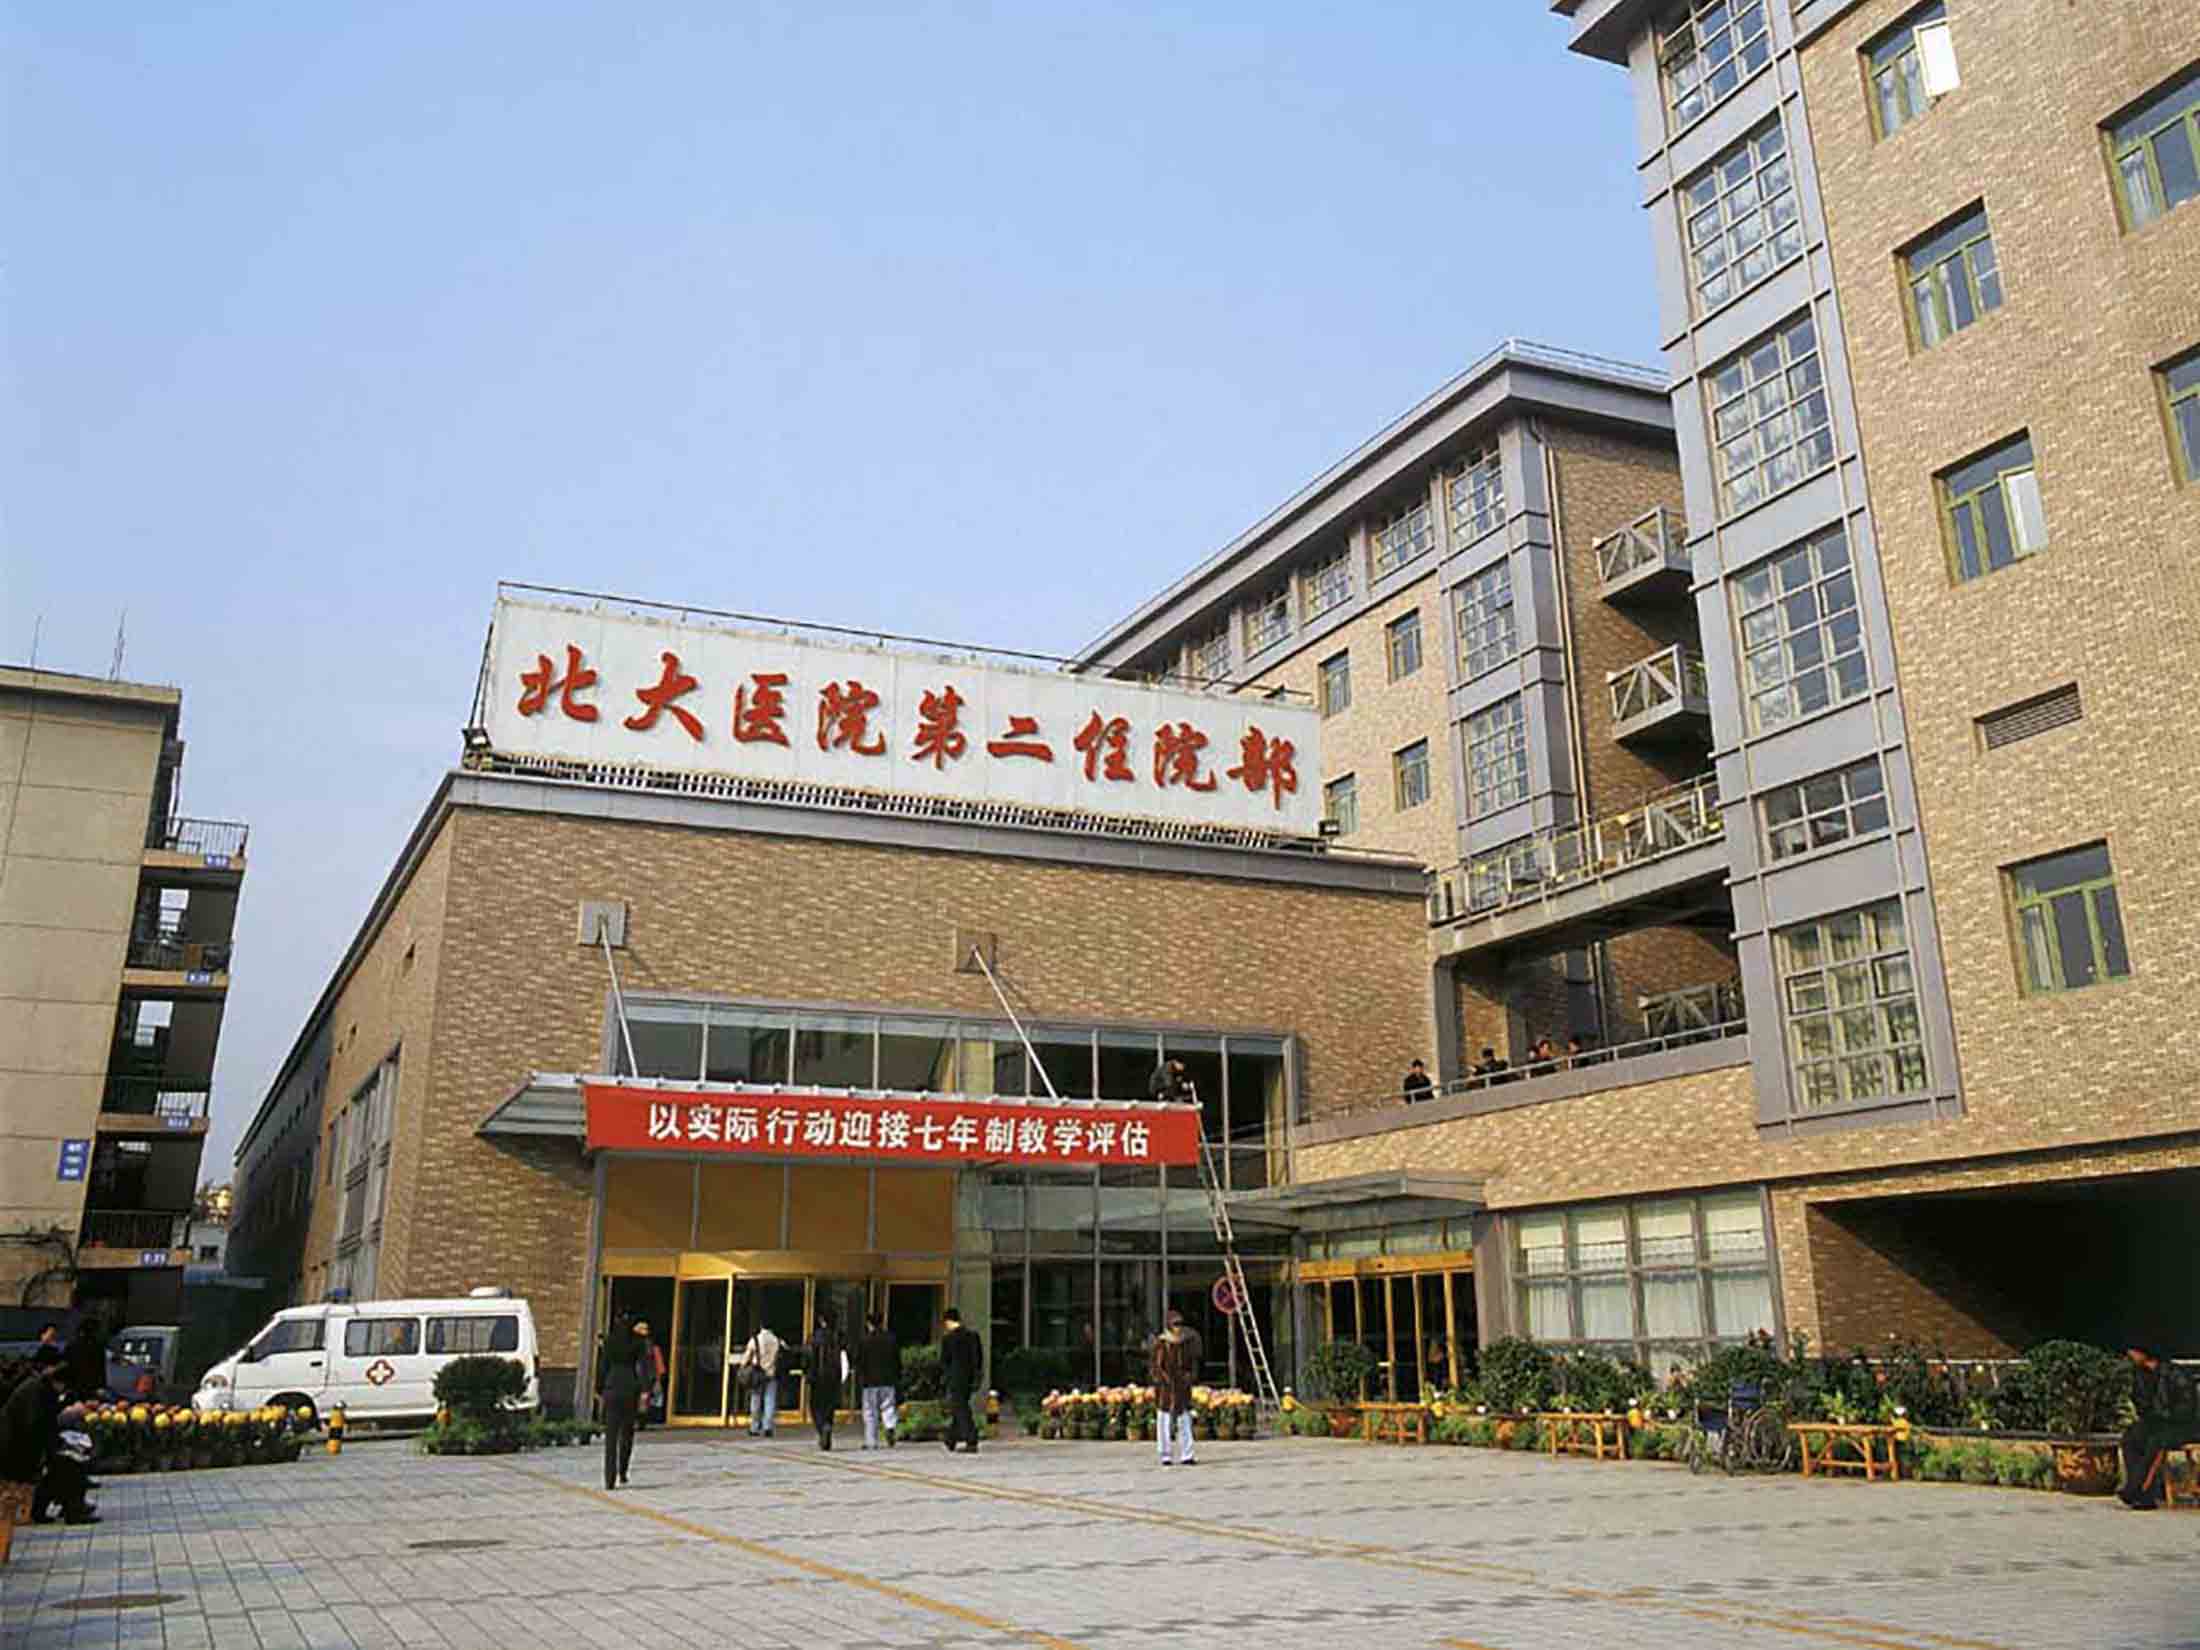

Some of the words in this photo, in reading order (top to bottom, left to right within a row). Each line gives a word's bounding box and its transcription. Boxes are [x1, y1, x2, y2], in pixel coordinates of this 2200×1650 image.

[518, 645, 1300, 811] 北大医院第二住院部
[648, 1103, 1150, 1157] 以实际行动迎接七年制教学评估
